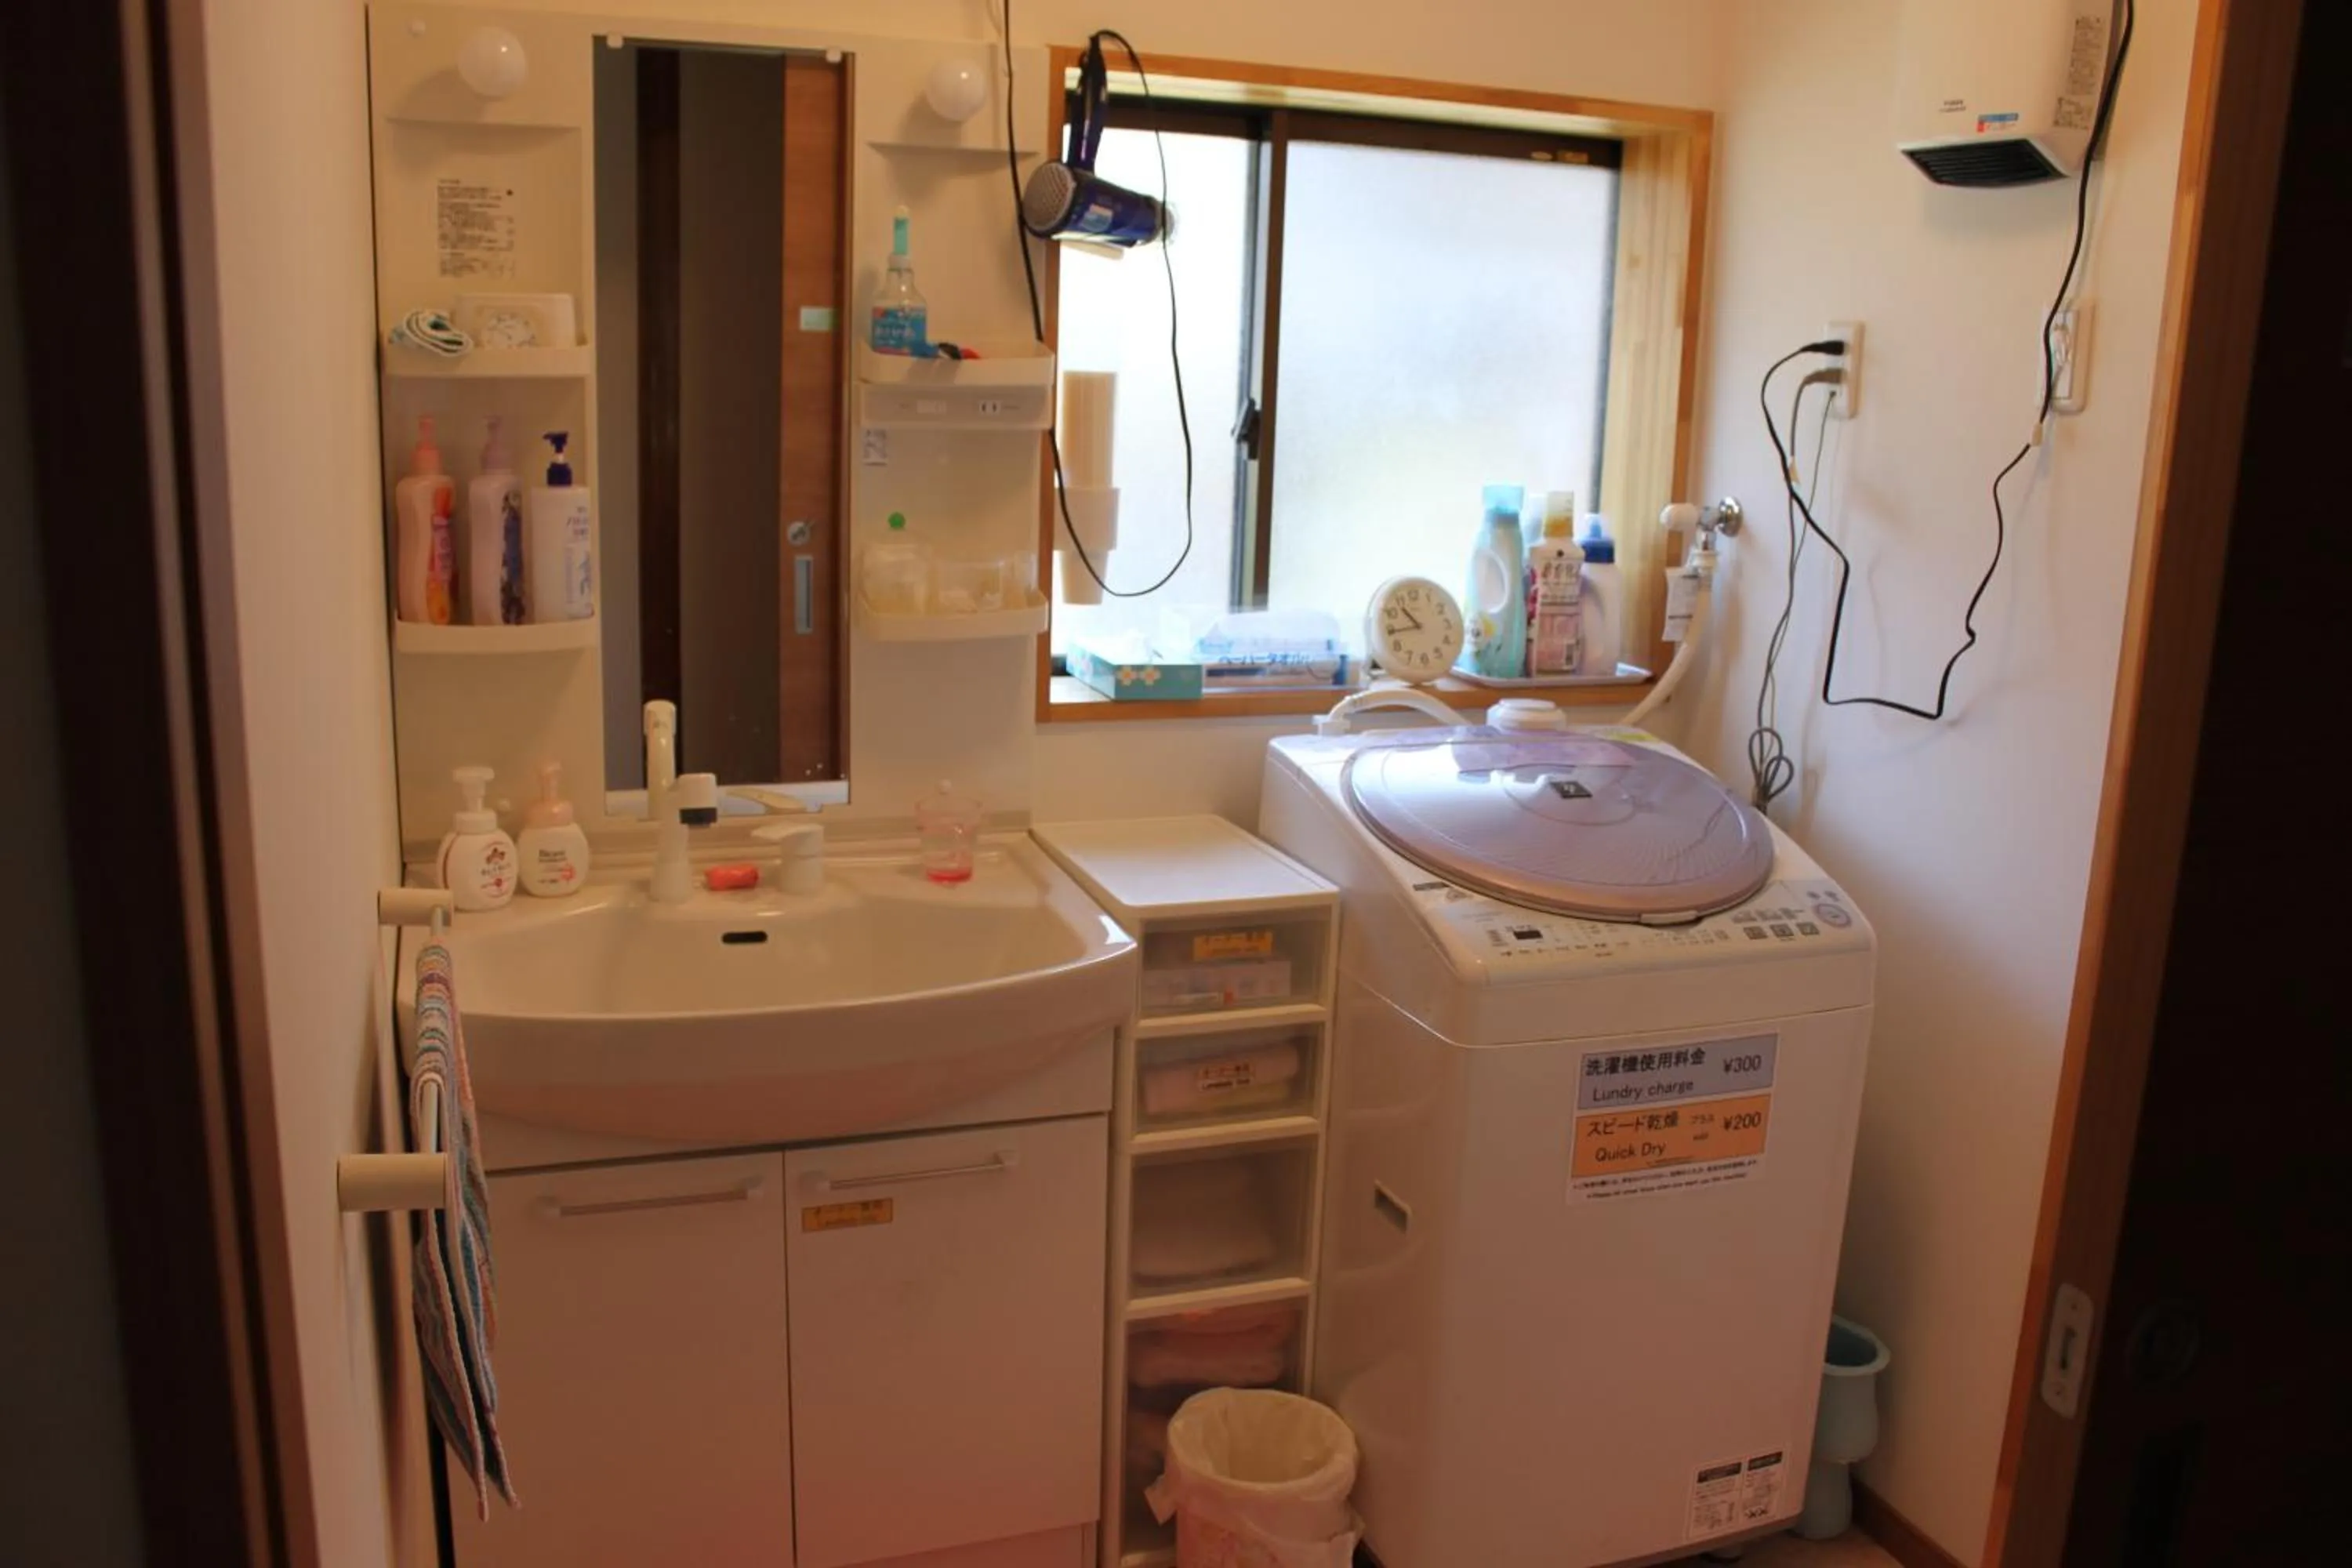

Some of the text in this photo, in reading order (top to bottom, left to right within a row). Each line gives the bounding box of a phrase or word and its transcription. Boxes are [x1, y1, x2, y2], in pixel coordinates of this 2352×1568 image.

[1585, 1047, 1762, 1076] 洗濯機使用料金 ¥300
[1593, 1080, 1693, 1102] Lundry charge
[1588, 1111, 1679, 1136] スピード乾燥
[1723, 1112, 1762, 1131] ¥200
[1595, 1141, 1666, 1162] Quick Dry
